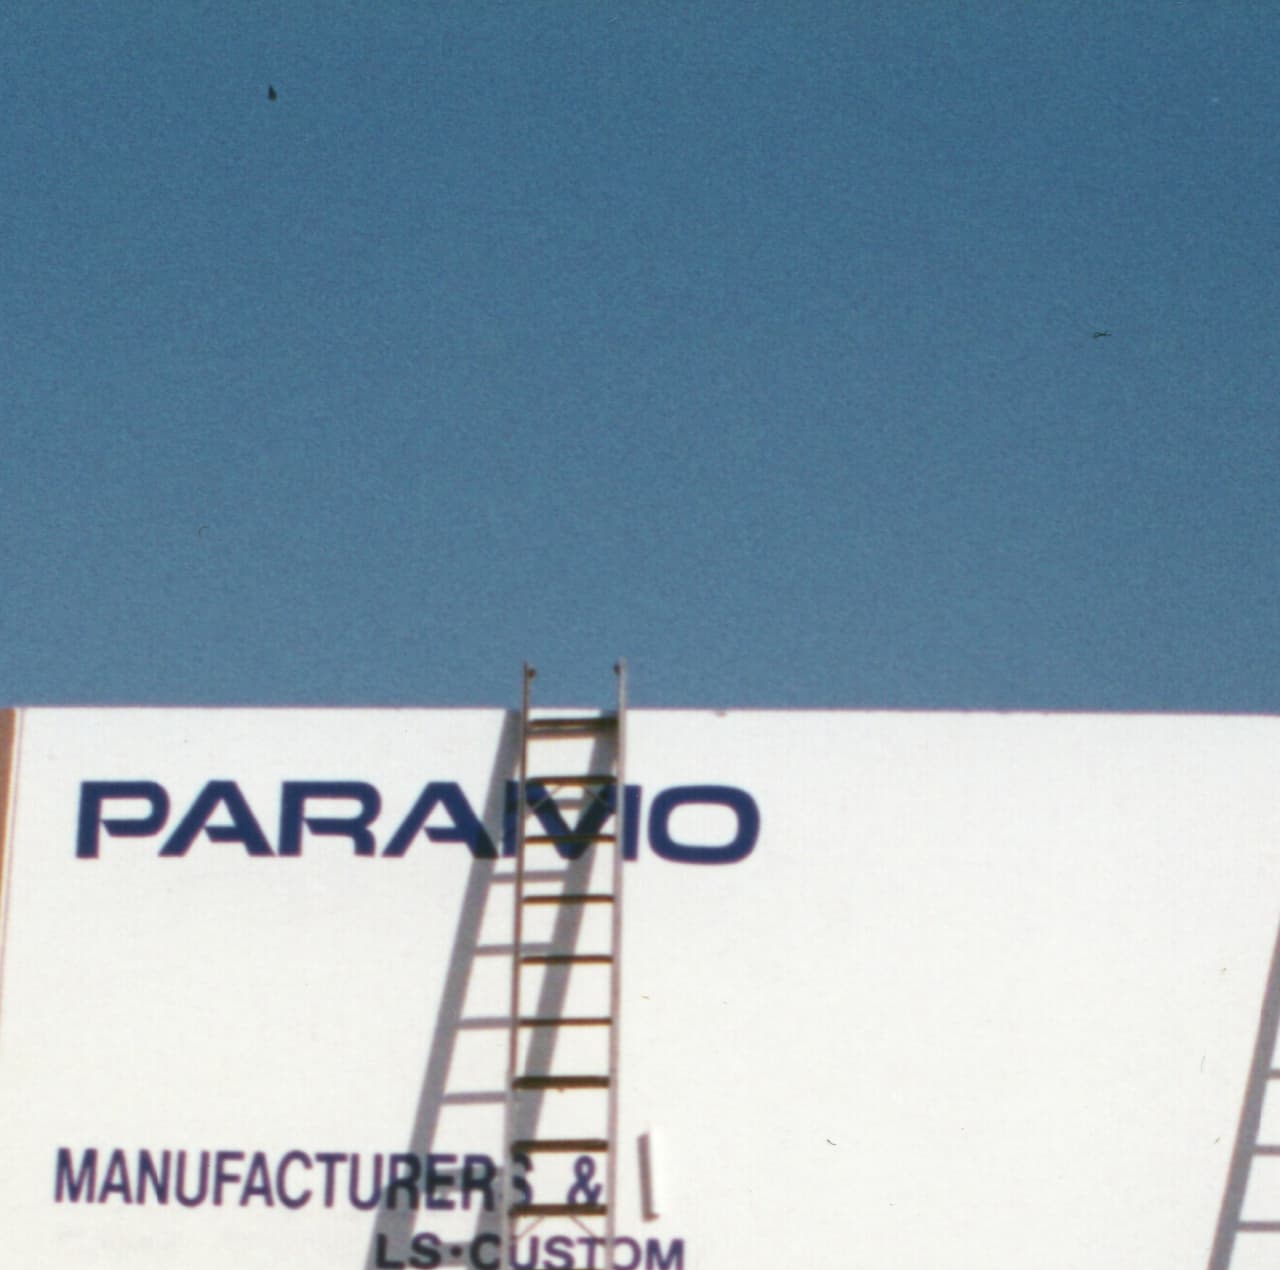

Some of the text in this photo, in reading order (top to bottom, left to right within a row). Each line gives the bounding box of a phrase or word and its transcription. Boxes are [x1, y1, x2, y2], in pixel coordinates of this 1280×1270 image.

[75, 779, 761, 865] PARAMO
[53, 1148, 603, 1211] MANUFACTURERS &
